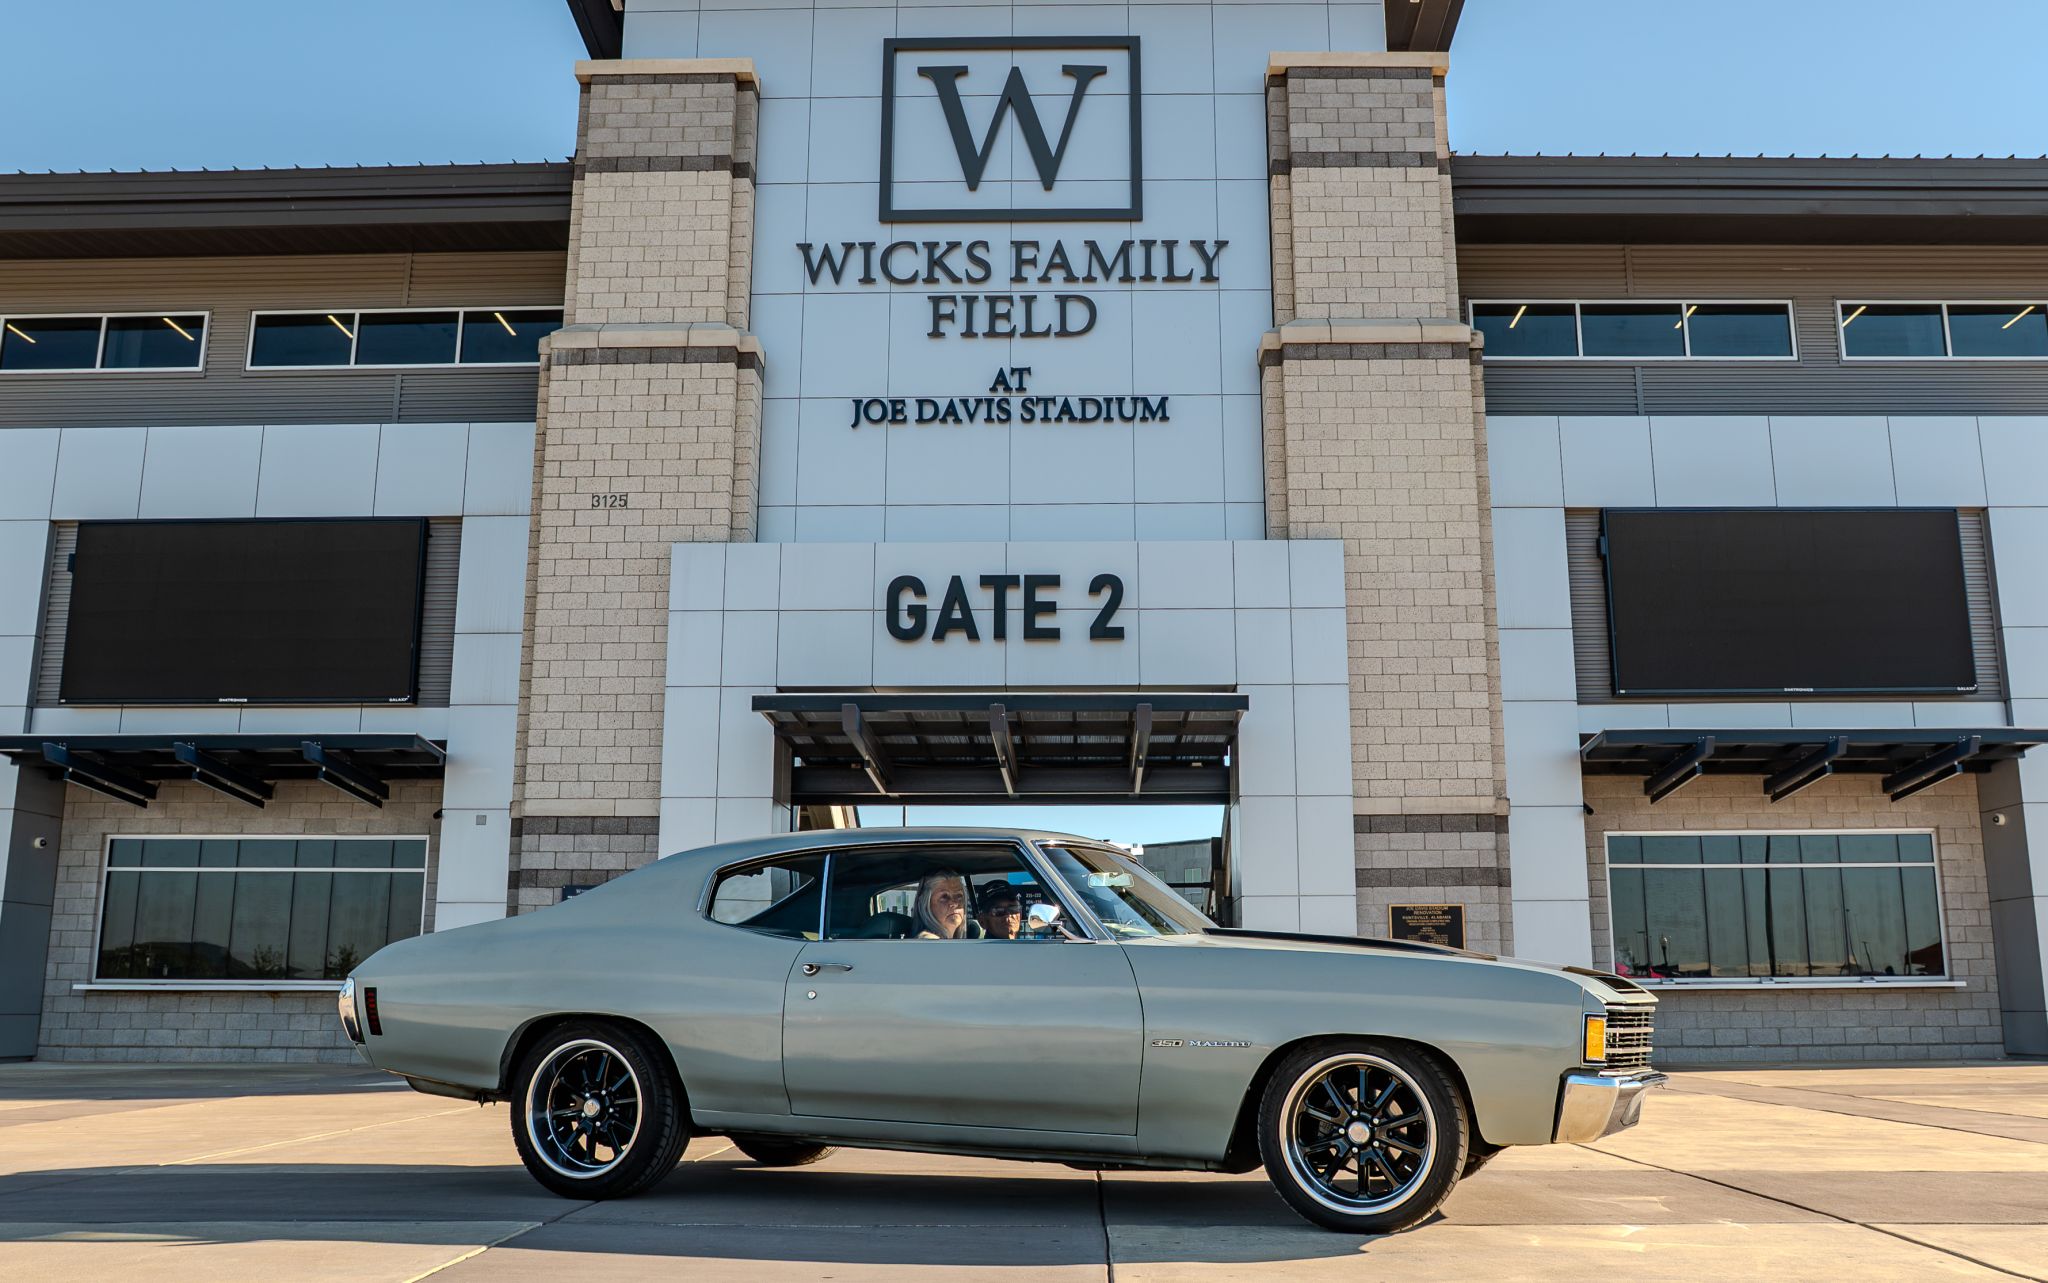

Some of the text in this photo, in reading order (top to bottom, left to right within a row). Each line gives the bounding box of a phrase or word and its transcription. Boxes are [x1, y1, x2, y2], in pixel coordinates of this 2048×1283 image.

[917, 64, 1107, 191] W
[797, 239, 1229, 285] WICKS FAMILY
[927, 294, 1098, 338] FIELD
[989, 366, 1031, 392] AT
[851, 396, 1170, 429] JOE DAVIS STADIUM
[592, 494, 628, 508] 3125
[886, 573, 1125, 641] GATE 2
[1151, 1039, 1252, 1048] 350 MALIBU
